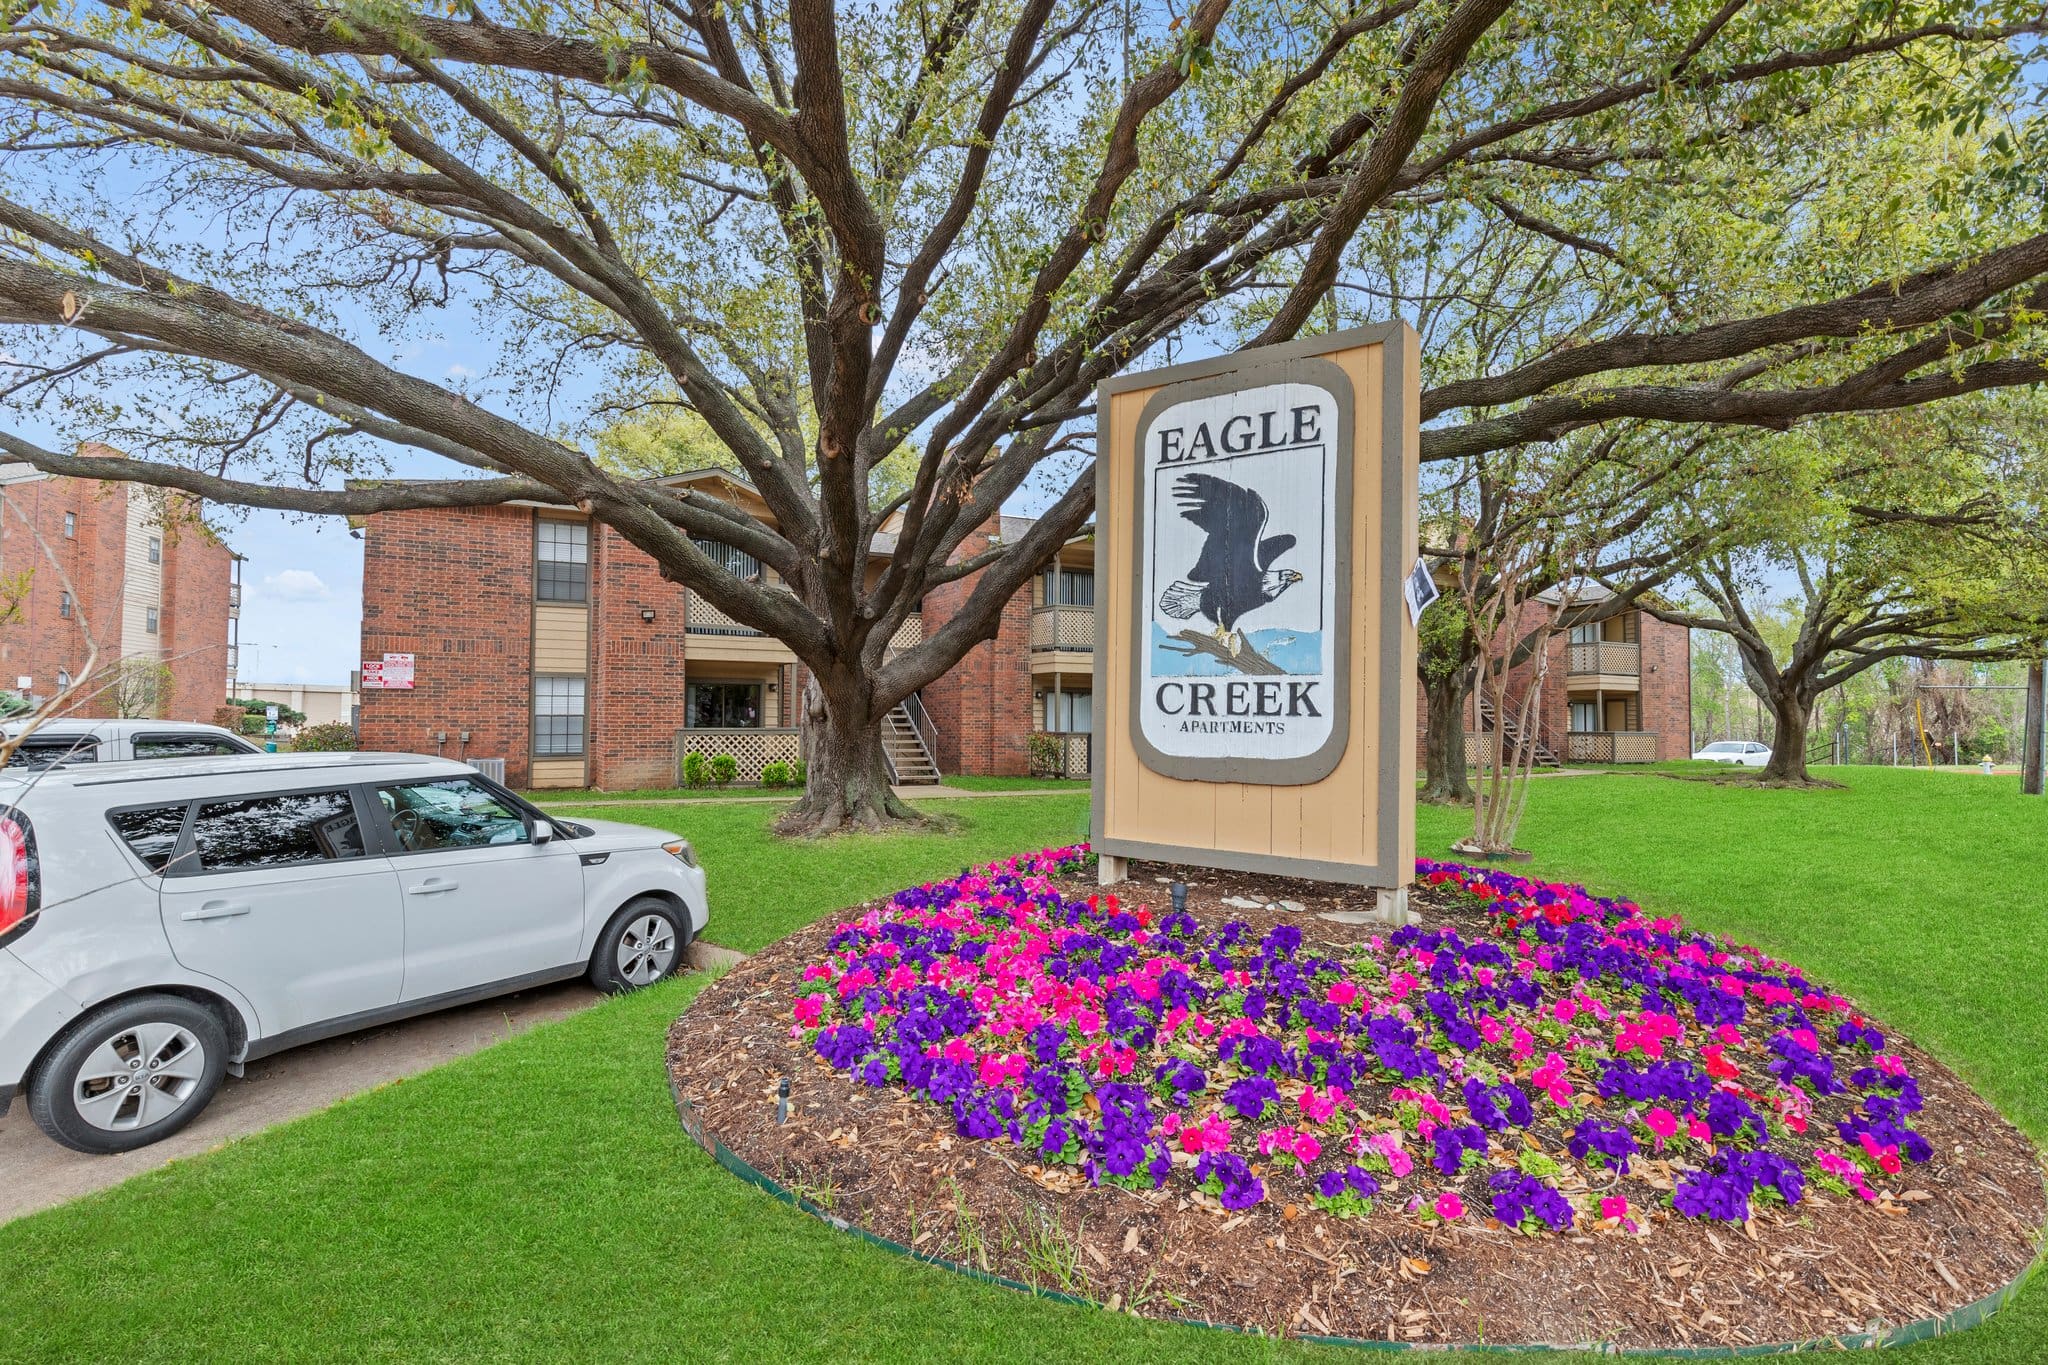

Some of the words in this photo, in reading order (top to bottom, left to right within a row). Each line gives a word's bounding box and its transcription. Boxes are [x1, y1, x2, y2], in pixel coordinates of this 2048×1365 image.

[1157, 404, 1321, 464] EAGLE
[1155, 681, 1322, 717] CREEK
[1179, 720, 1285, 734] APARTMENTS
